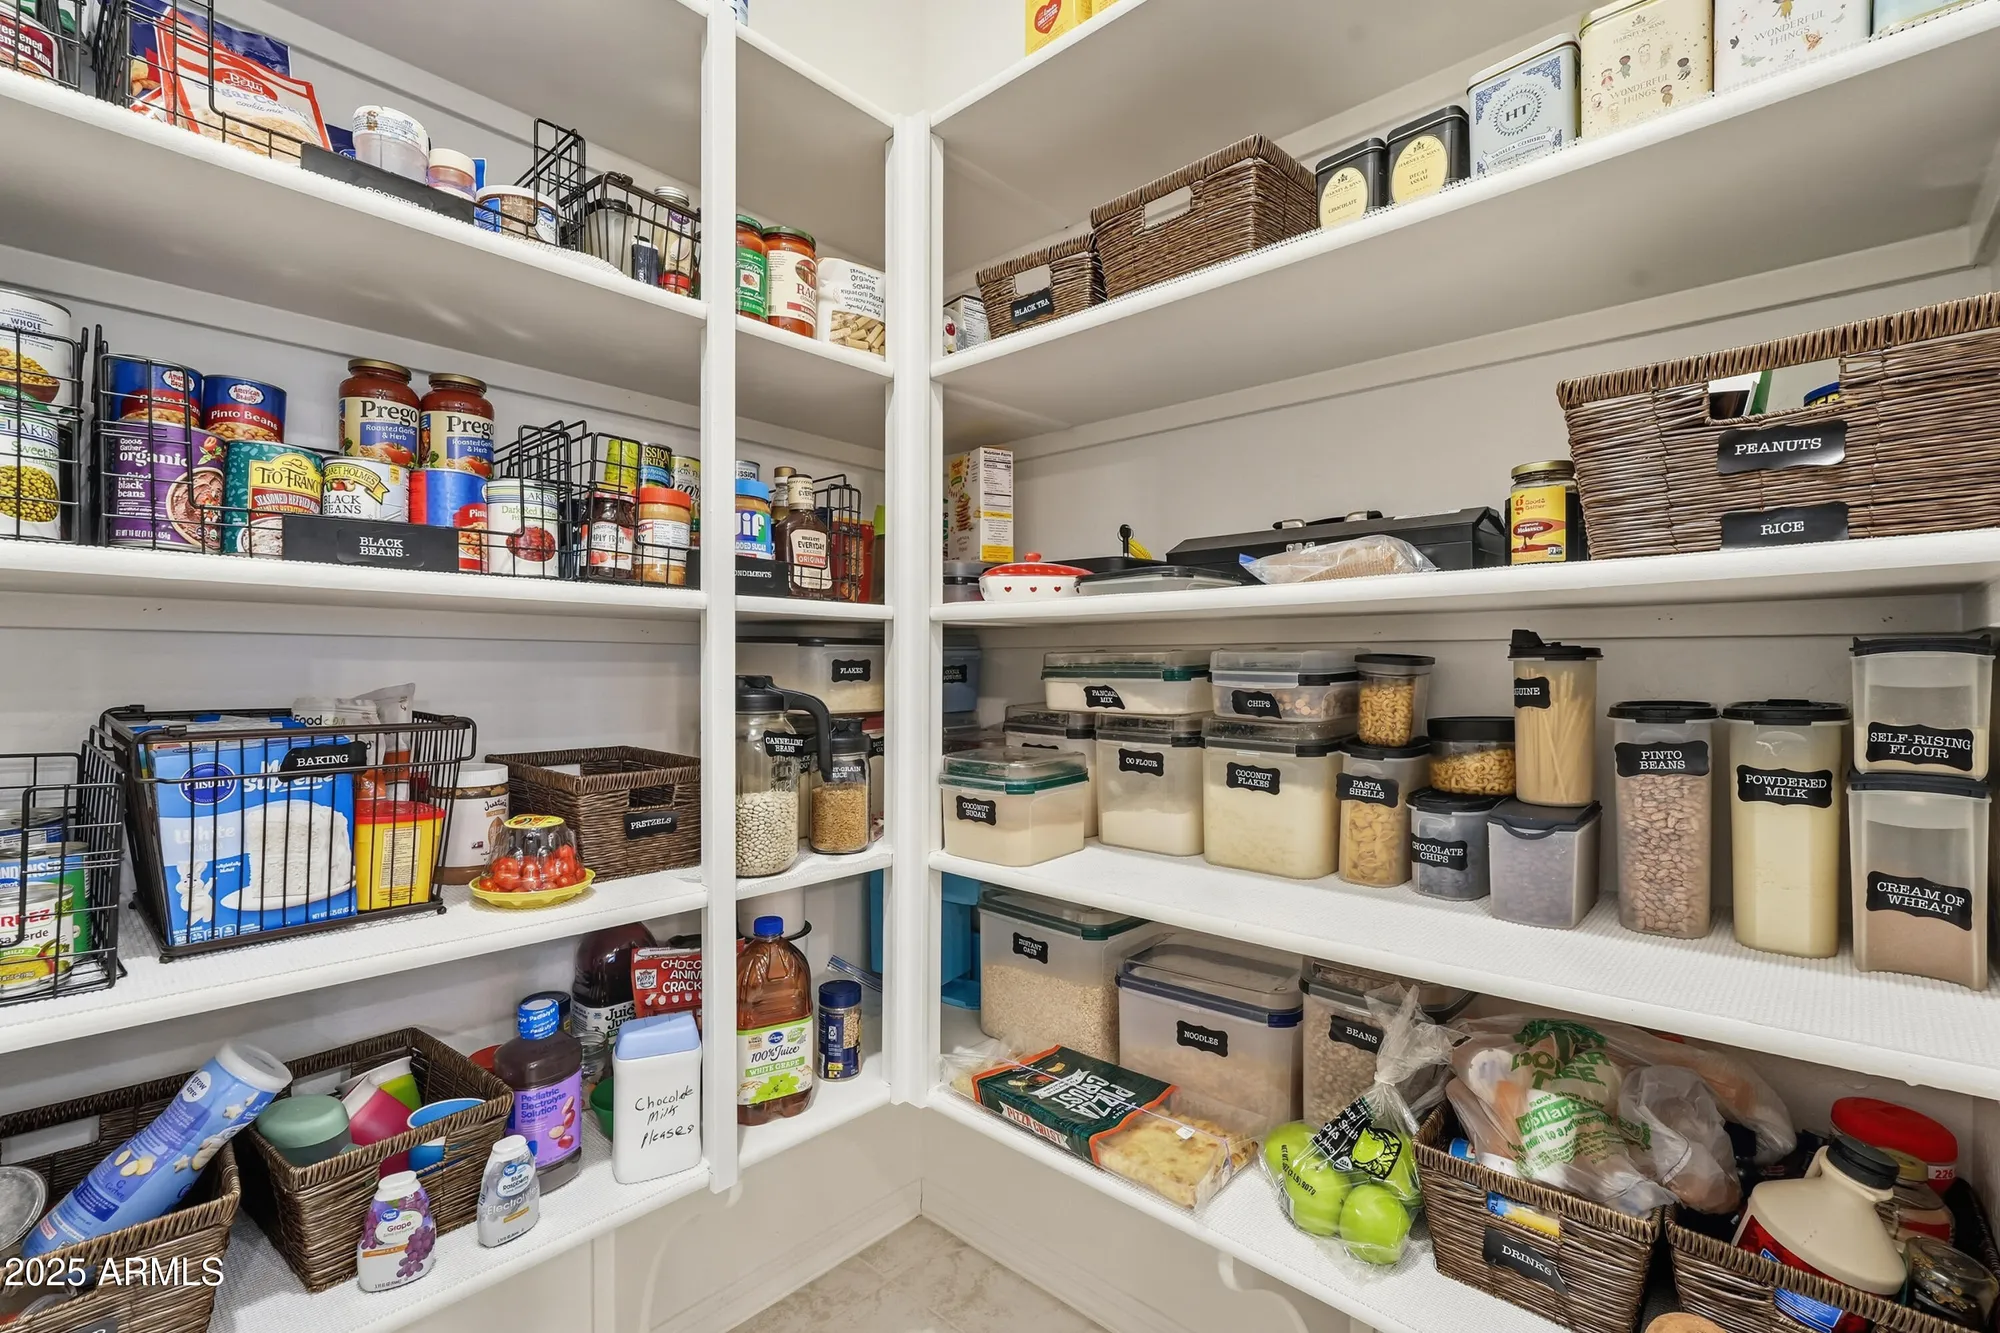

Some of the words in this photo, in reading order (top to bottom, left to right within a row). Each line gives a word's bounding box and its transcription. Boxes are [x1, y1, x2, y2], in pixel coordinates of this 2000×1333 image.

[1754, 10, 1826, 41] WONDERFUL
[1770, 26, 1811, 46] THINGS
[1610, 74, 1670, 100] WONDERFUL
[1624, 87, 1657, 105] THINGS
[1504, 101, 1532, 122] HT
[1328, 198, 1358, 215] CHOCOLATE
[850, 274, 876, 286] Organic
[1014, 304, 1037, 317] BLACK
[1037, 298, 1050, 311] TEA
[11, 317, 42, 331] WHOLE
[211, 409, 241, 420] Pinto
[244, 410, 279, 431] Beans
[360, 400, 418, 428] Prego
[366, 424, 398, 434] Roasted
[398, 426, 416, 437] Garlic
[446, 415, 495, 441] Prego
[382, 431, 388, 440] &
[389, 432, 407, 441] Herb
[452, 438, 480, 448] Roasted
[466, 445, 472, 454] &
[473, 446, 488, 454] Herb
[1734, 438, 1822, 455] PEANUTS
[342, 466, 378, 486] HOLMES
[118, 480, 144, 490] black
[118, 490, 146, 499] beans
[254, 494, 288, 506] SEASONED
[323, 494, 361, 506] BLACK
[323, 504, 362, 516] BEANS
[1760, 521, 1805, 536] RICE
[359, 536, 404, 549] BLACK
[798, 541, 825, 552] EVERYDAY
[359, 546, 404, 558] BEANS
[798, 556, 826, 566] ORIGINAL
[840, 667, 863, 675] FLAKES
[1247, 700, 1271, 708] CHIPS
[765, 737, 804, 747] CANNELLINI
[1870, 732, 1971, 751] SELF-RISING
[1641, 750, 1683, 760] PINTO
[1889, 745, 1949, 759] FLOUR
[297, 754, 350, 767] BAKING
[1135, 758, 1158, 768] FLOUR
[1639, 760, 1686, 770] BEANS
[1236, 769, 1272, 781] COCONUT
[1745, 774, 1827, 789] POWDERED
[1238, 777, 1270, 788] FLAKES
[1353, 780, 1382, 791] PASTA
[1350, 788, 1385, 800] SHELLS
[1765, 786, 1808, 799] MILK
[962, 802, 990, 813] COCONUT
[966, 809, 986, 819] SUGAR
[630, 817, 672, 830] PRETZELS
[1412, 841, 1464, 857] CHOCOLATE
[1420, 852, 1449, 863] CHIPS
[1877, 881, 1941, 901] CREAM
[1944, 893, 1965, 908] OF
[1888, 894, 1953, 915] WHEAT
[1018, 938, 1043, 951] INSTANT
[1023, 946, 1038, 956] OATS
[1184, 1030, 1219, 1046] NOODLES
[1345, 1026, 1379, 1045] BEANS
[751, 1049, 775, 1063] 100%
[769, 1045, 800, 1062] Juice
[749, 1066, 774, 1076] WHITE
[775, 1060, 800, 1072] GRAPE
[190, 1074, 208, 1091] grow
[186, 1084, 199, 1098] love
[521, 1086, 560, 1103] Pediatric
[1051, 1074, 1110, 1113] CRUST
[521, 1092, 567, 1111] Electrolyte
[1071, 1081, 1137, 1120] PIZZA
[521, 1104, 558, 1119] Solution
[1006, 1106, 1034, 1131] PIZZA
[1033, 1122, 1062, 1145] CRUST
[1301, 1181, 1317, 1196] 907g
[387, 1220, 412, 1233] Grape
[1502, 1244, 1552, 1276] DRINKS
